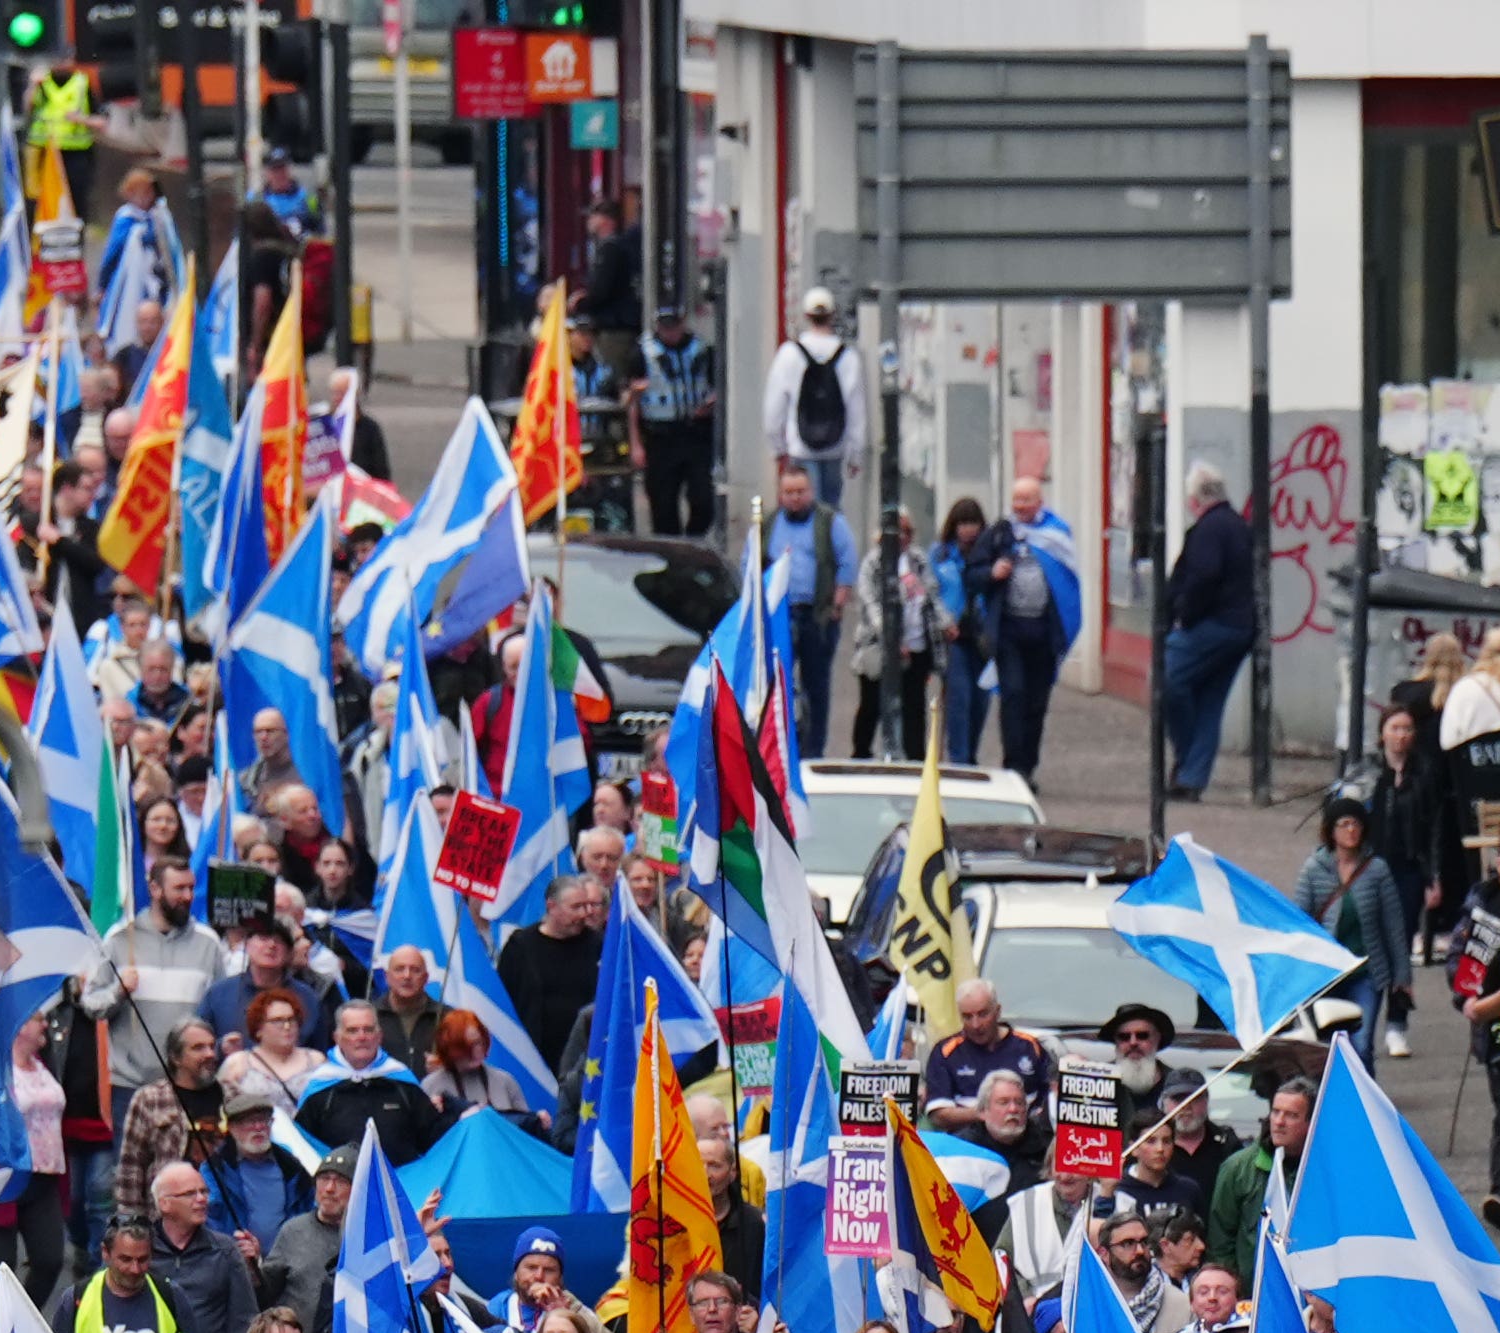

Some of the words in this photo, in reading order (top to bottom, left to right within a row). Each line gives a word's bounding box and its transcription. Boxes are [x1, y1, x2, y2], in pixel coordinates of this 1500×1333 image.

[436, 867, 454, 883] NO
[455, 873, 470, 890] TO
[471, 880, 498, 899] WAR
[846, 1075, 911, 1095] FREEDOM
[1061, 1074, 1116, 1100] FREEDOM
[1059, 1102, 1118, 1128] PALESTINE
[1068, 1129, 1108, 1149] الحرية
[1062, 1150, 1113, 1167] لفلسطين
[832, 1212, 881, 1244] Now
